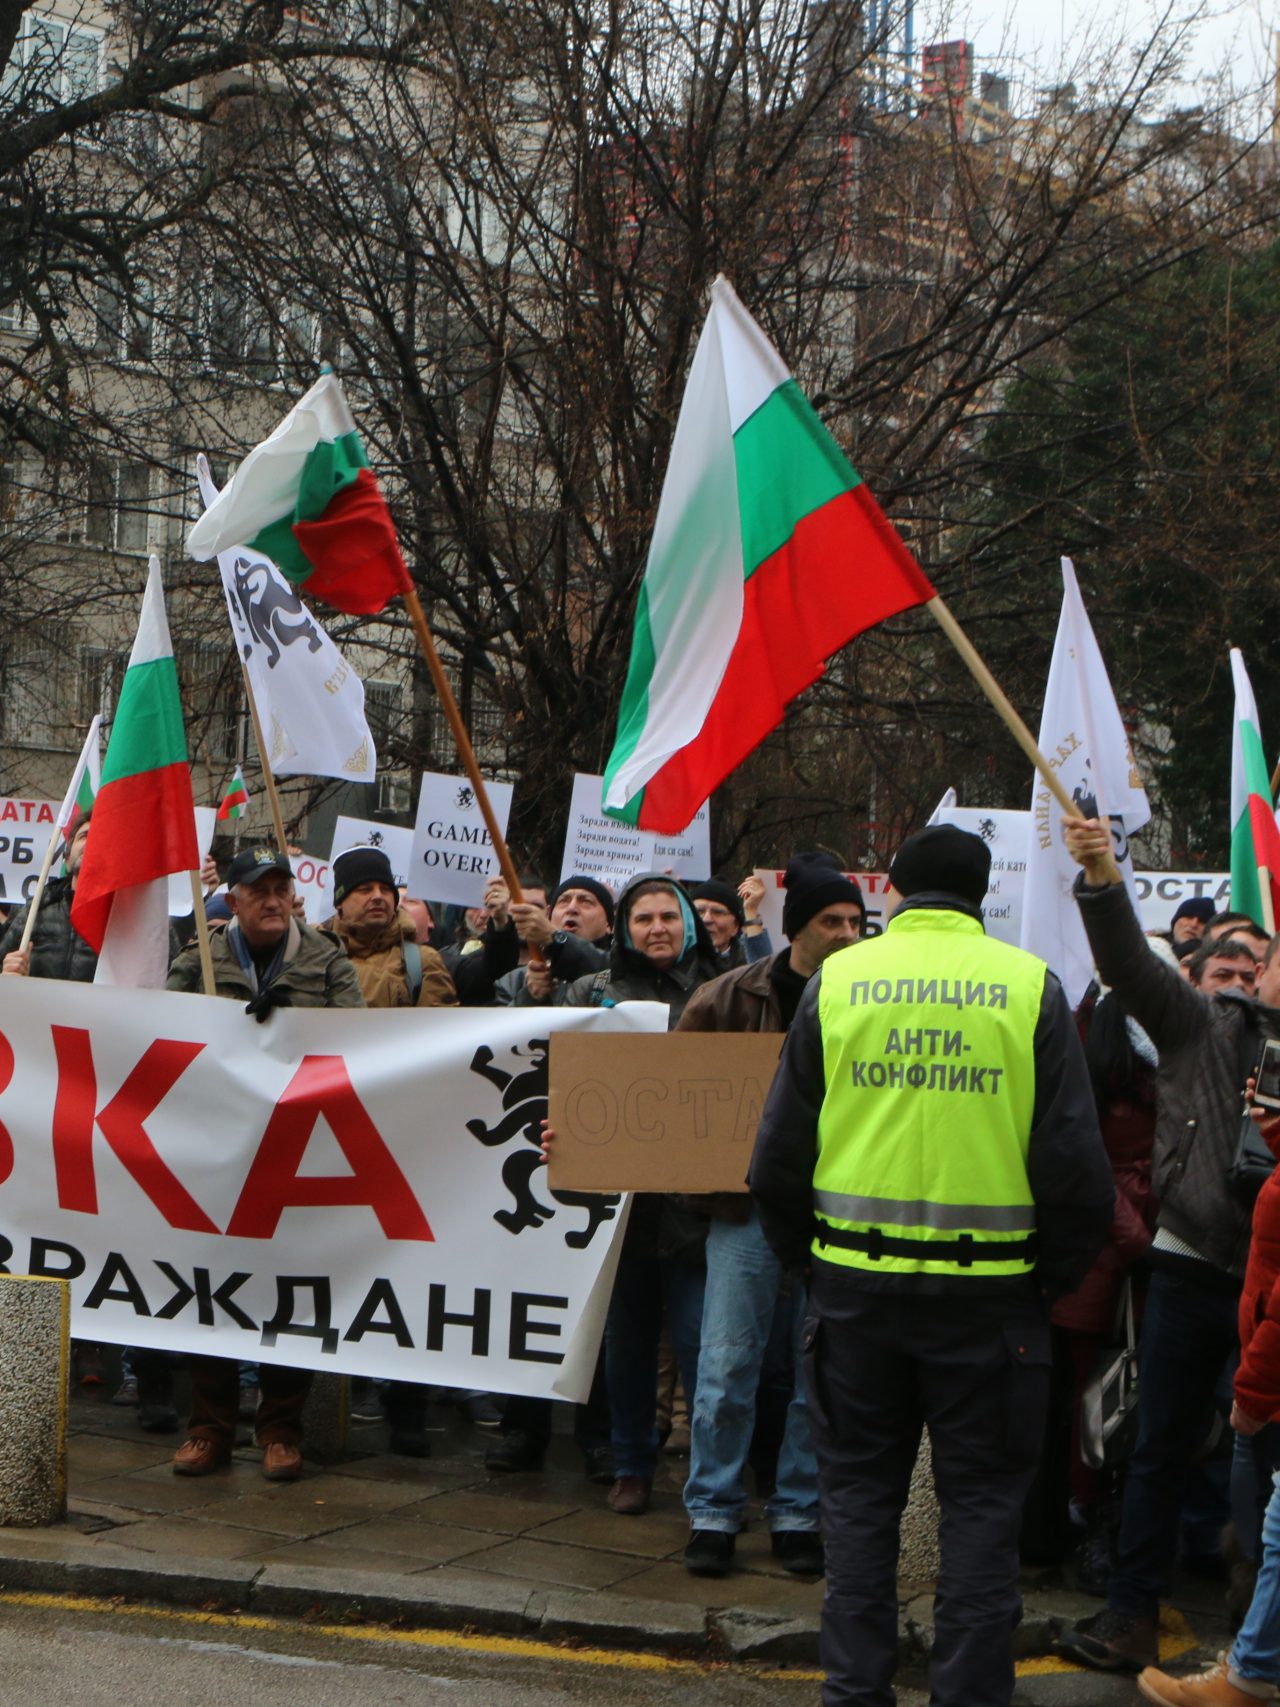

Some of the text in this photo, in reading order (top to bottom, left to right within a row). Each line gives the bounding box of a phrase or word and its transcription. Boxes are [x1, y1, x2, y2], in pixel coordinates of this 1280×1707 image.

[427, 820, 493, 847] GAME
[423, 849, 491, 875] OVER!
[850, 978, 1008, 1010] ПОЛИЦИЯ
[884, 1028, 972, 1057] АНТИ-
[851, 1060, 1004, 1095] КОНФЛИКТ
